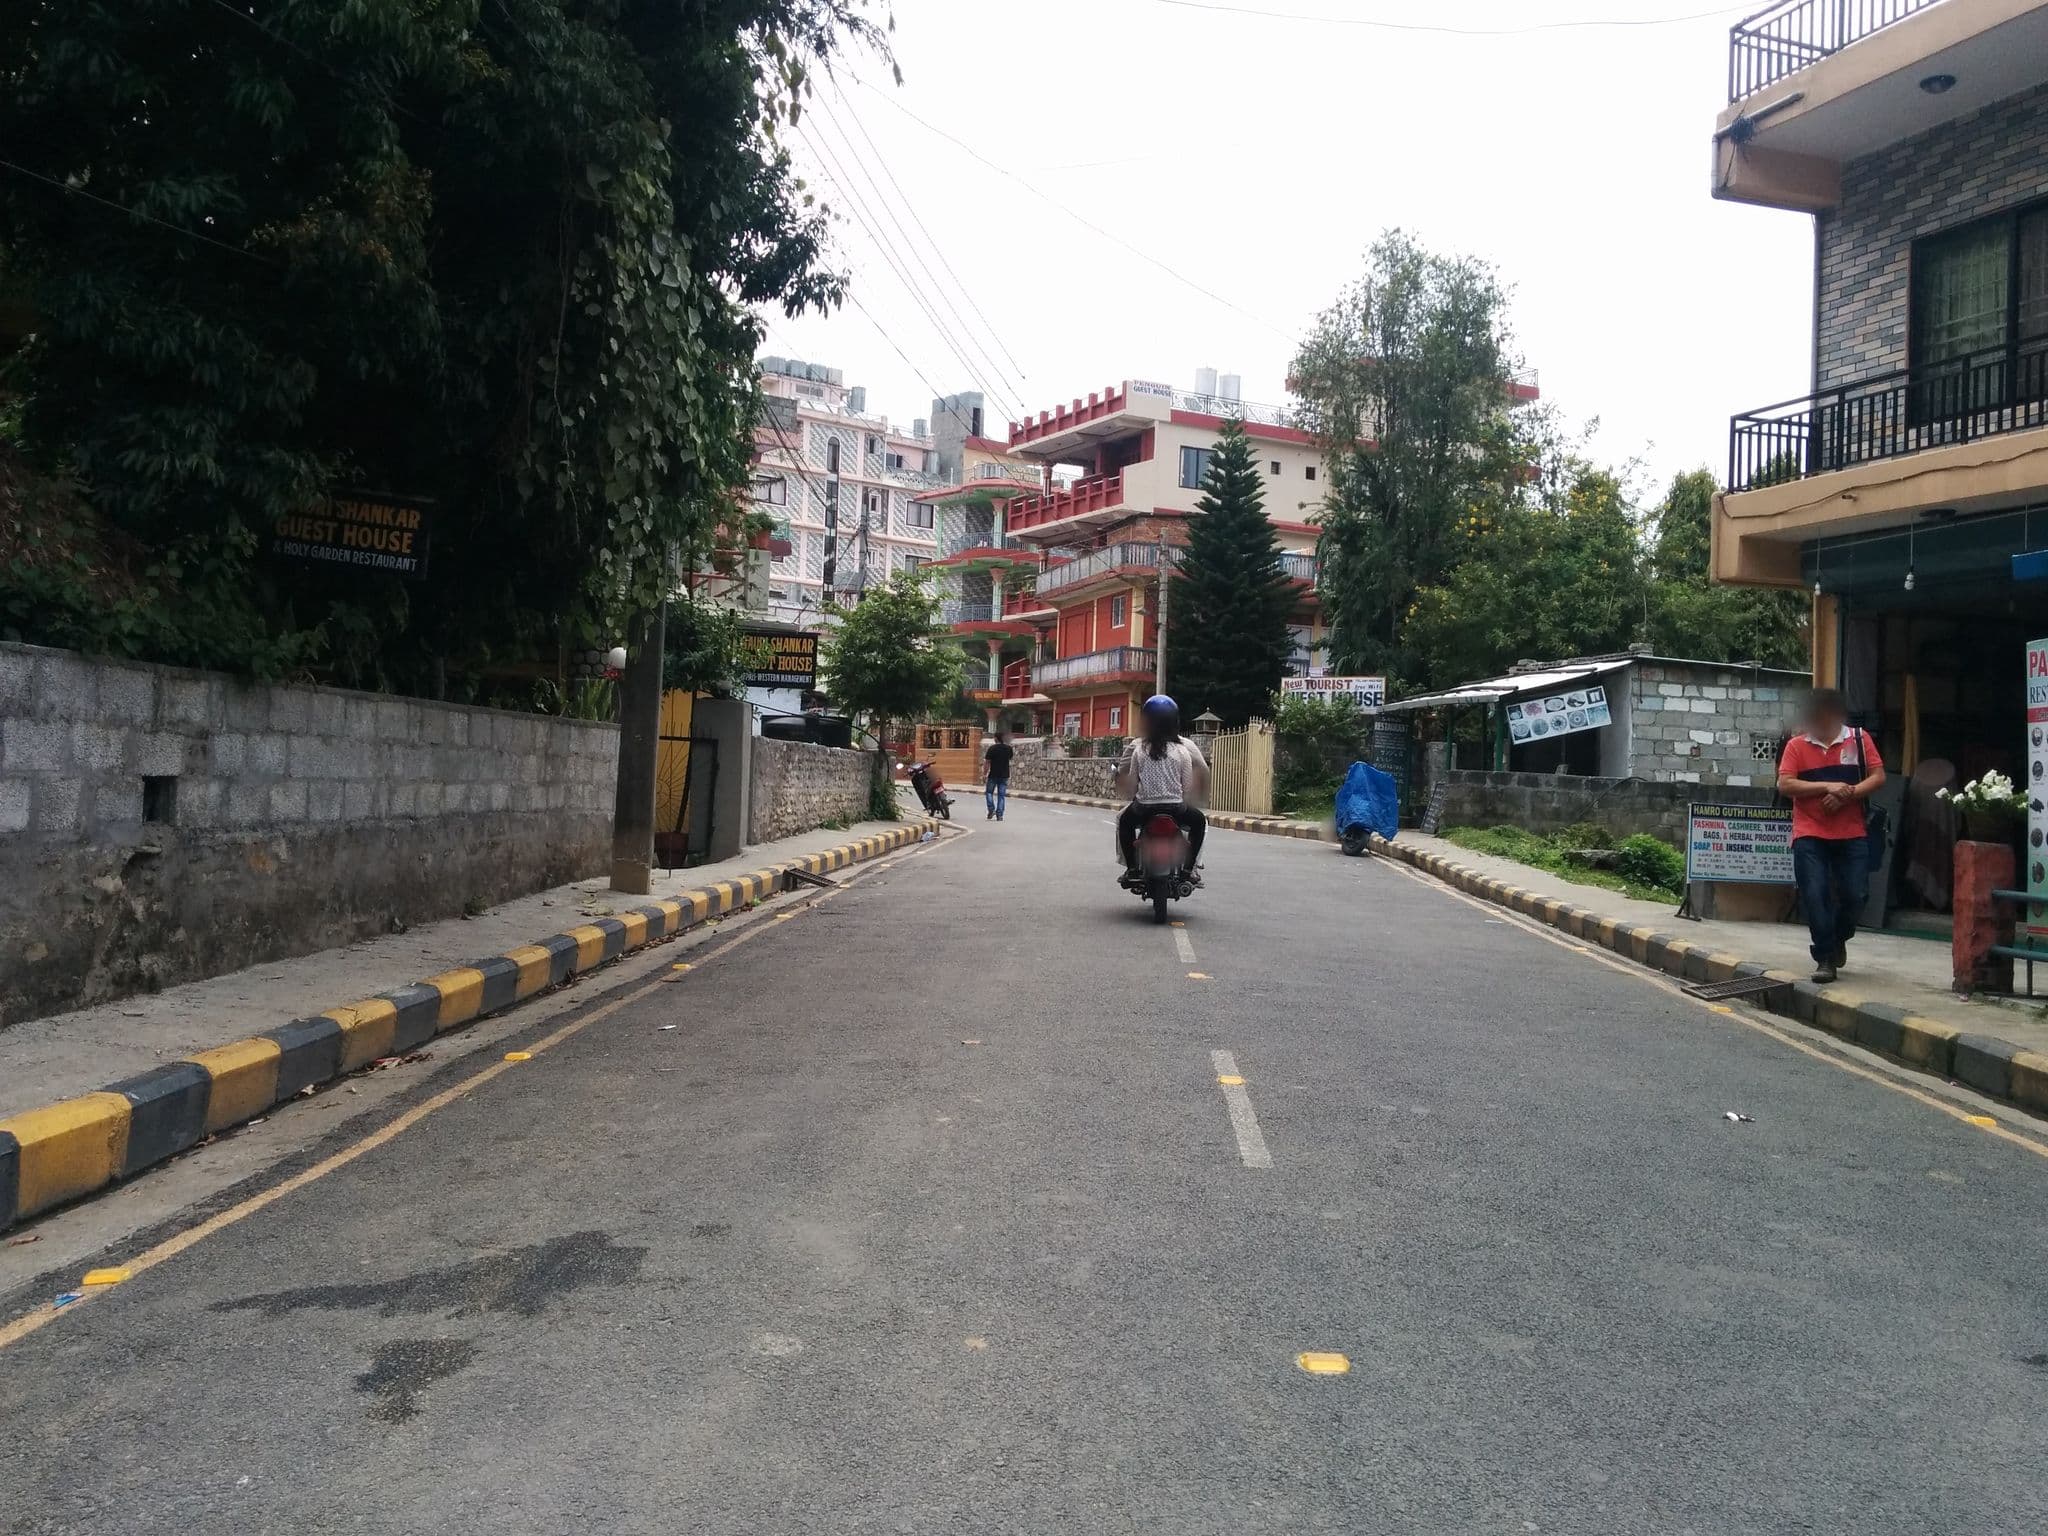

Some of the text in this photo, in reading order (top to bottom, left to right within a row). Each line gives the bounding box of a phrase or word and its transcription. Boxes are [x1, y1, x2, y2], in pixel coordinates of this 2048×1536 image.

[1133, 385, 1171, 397] GUEST HOUSE
[336, 500, 421, 529] SHANKAR
[275, 515, 415, 554] GUEST HOUSE
[284, 541, 311, 557] HOLY
[310, 545, 352, 563] GARDEN
[352, 551, 418, 572] RESTAURANT
[771, 637, 814, 654] SHANKAR
[778, 656, 813, 672] HOUSE
[1284, 680, 1303, 690] New
[1304, 679, 1353, 690] TOURIST
[2030, 685, 2048, 704] RES
[1694, 805, 1720, 816] HAMRO
[1722, 806, 1746, 817] GUTHI
[1728, 822, 1763, 832] CASHMERE,
[1764, 824, 1776, 833] YAK
[1778, 824, 1793, 833] WOO
[1703, 831, 1787, 843] BAGS, & HERBAL PRODUCTS
[1755, 844, 1785, 854] MASSAGE
